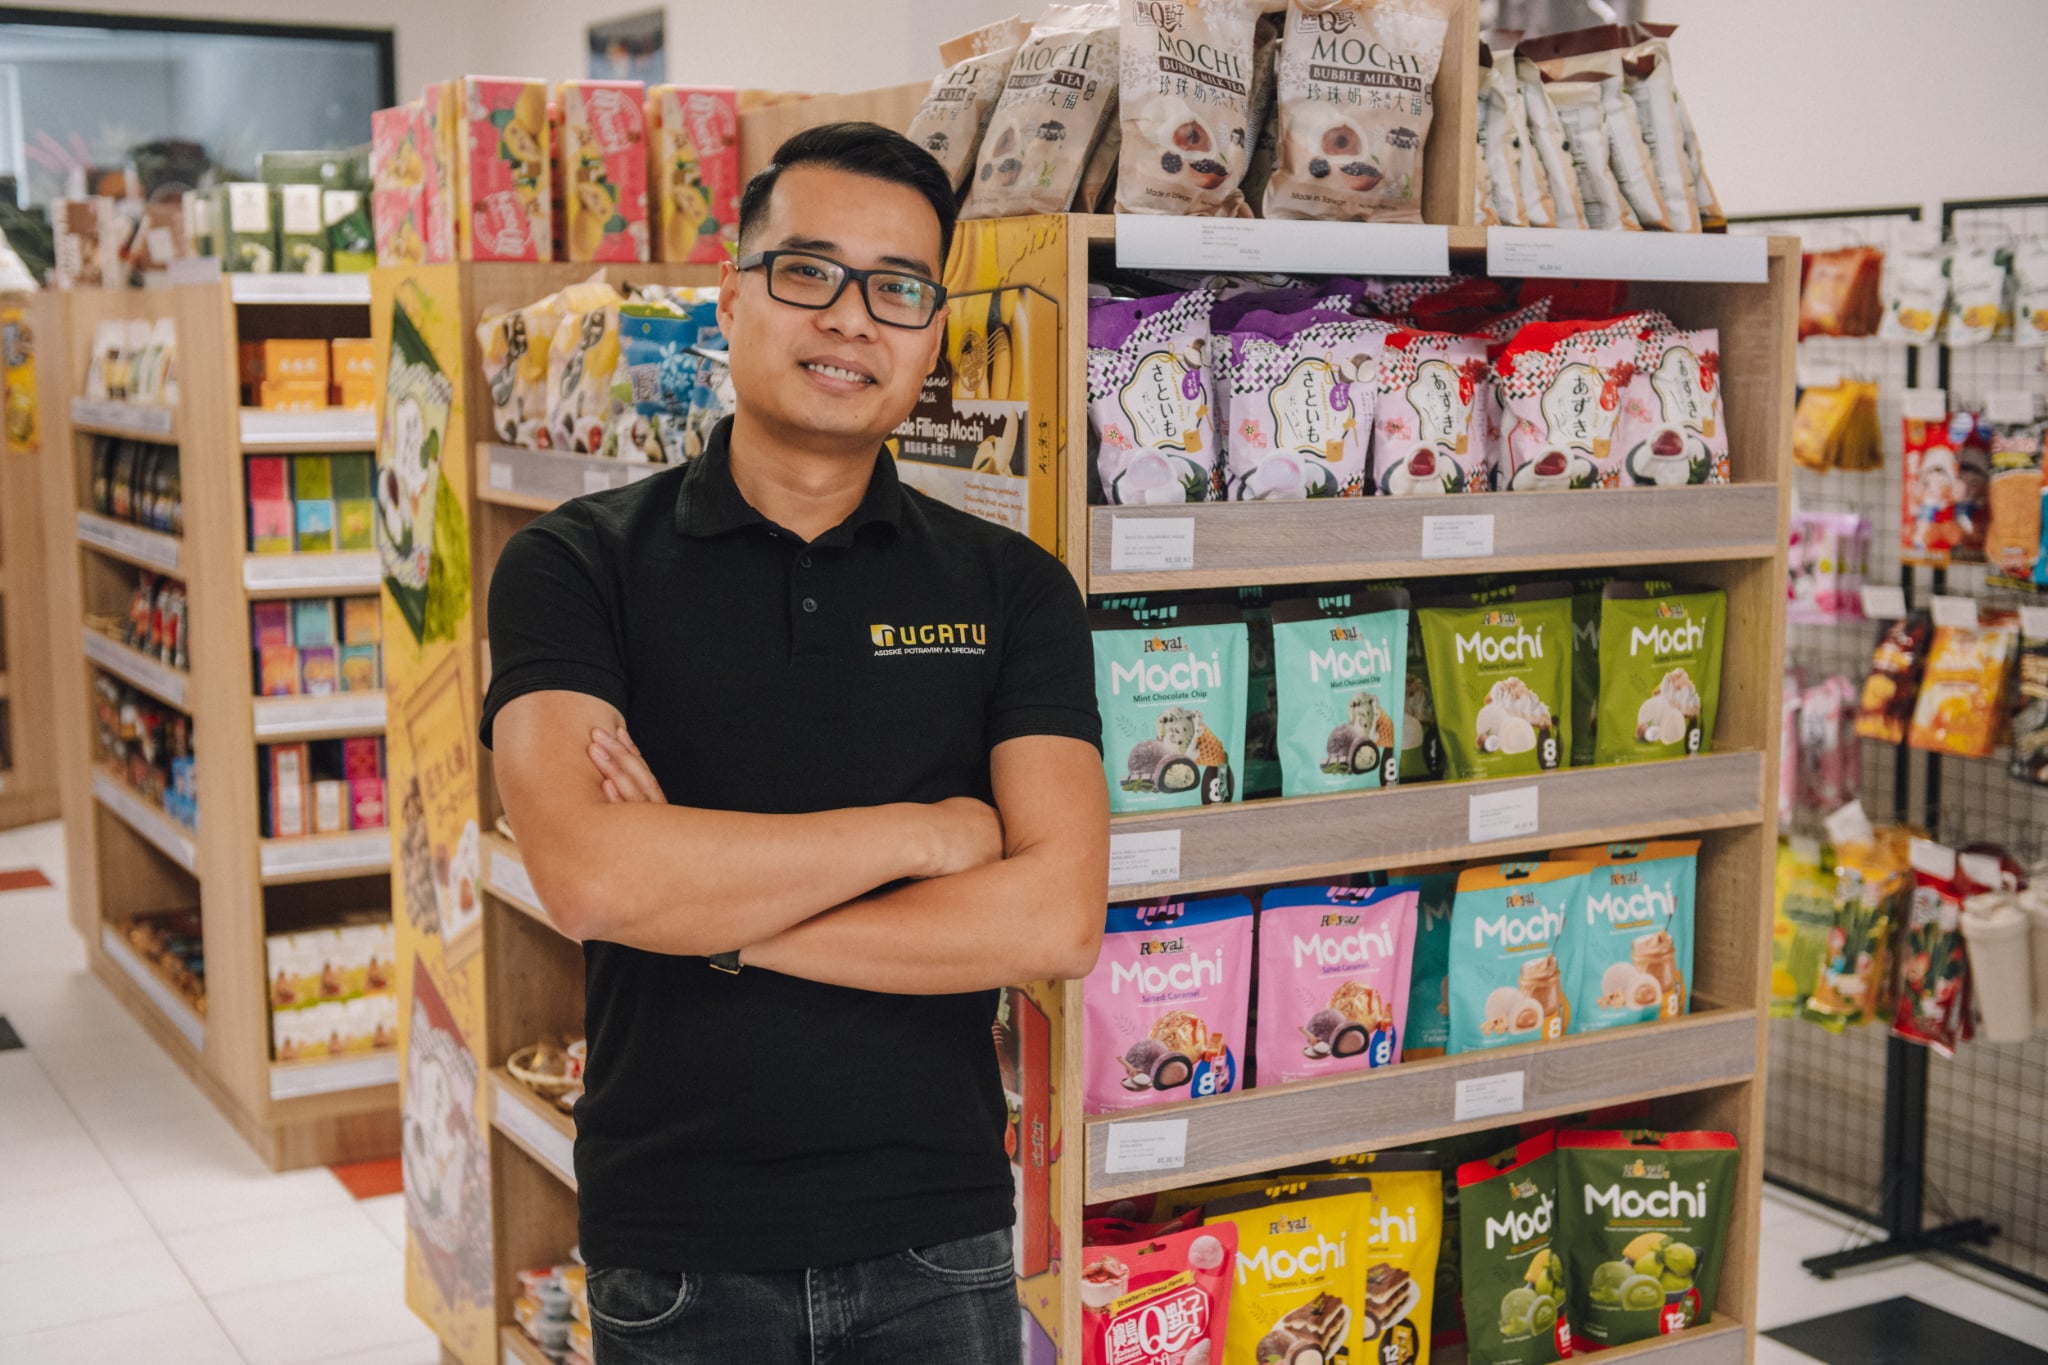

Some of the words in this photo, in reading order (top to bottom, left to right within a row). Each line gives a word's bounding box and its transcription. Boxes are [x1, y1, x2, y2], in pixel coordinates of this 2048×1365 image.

[1158, 32, 1241, 79] MOCHI
[1311, 35, 1421, 74] MOCHI
[1059, 73, 1081, 87] TEA
[1163, 58, 1200, 80] BUBBLE
[1200, 73, 1226, 88] MILK
[1227, 82, 1245, 94] TEA
[1313, 66, 1361, 82] BUBBLE
[1363, 73, 1398, 86] MILK
[1400, 76, 1421, 90] TEA
[1152, 363, 1177, 437] さといも
[1303, 369, 1320, 443] さといも
[1571, 374, 1592, 438] あずき
[950, 419, 984, 442] Mochi
[1455, 625, 1544, 664] Mochi
[1630, 617, 1707, 657] Mochi
[1111, 649, 1222, 696] Mochi
[1309, 638, 1392, 683] Mochi
[1133, 694, 1151, 703] Mint
[1152, 691, 1189, 702] Chocolate
[1191, 689, 1208, 699] Chip
[1543, 738, 1558, 762] 8
[1688, 728, 1700, 751] 8
[1384, 757, 1397, 781] 8
[1587, 881, 1676, 926] Mochi
[1475, 902, 1566, 948] Mochi
[1293, 921, 1394, 969] Mochi
[1111, 948, 1223, 994] Mochi
[1142, 993, 1166, 1003] Salted
[1667, 994, 1678, 1016] 8
[1549, 1016, 1562, 1038] 8
[1375, 1041, 1391, 1065] 8
[1198, 1072, 1216, 1094] 8
[1584, 1181, 1706, 1218] Mochi
[1486, 1188, 1555, 1250] Moch
[1235, 1231, 1347, 1285] Mochi
[1665, 1313, 1685, 1330] 12
[1383, 1344, 1399, 1362] 12
